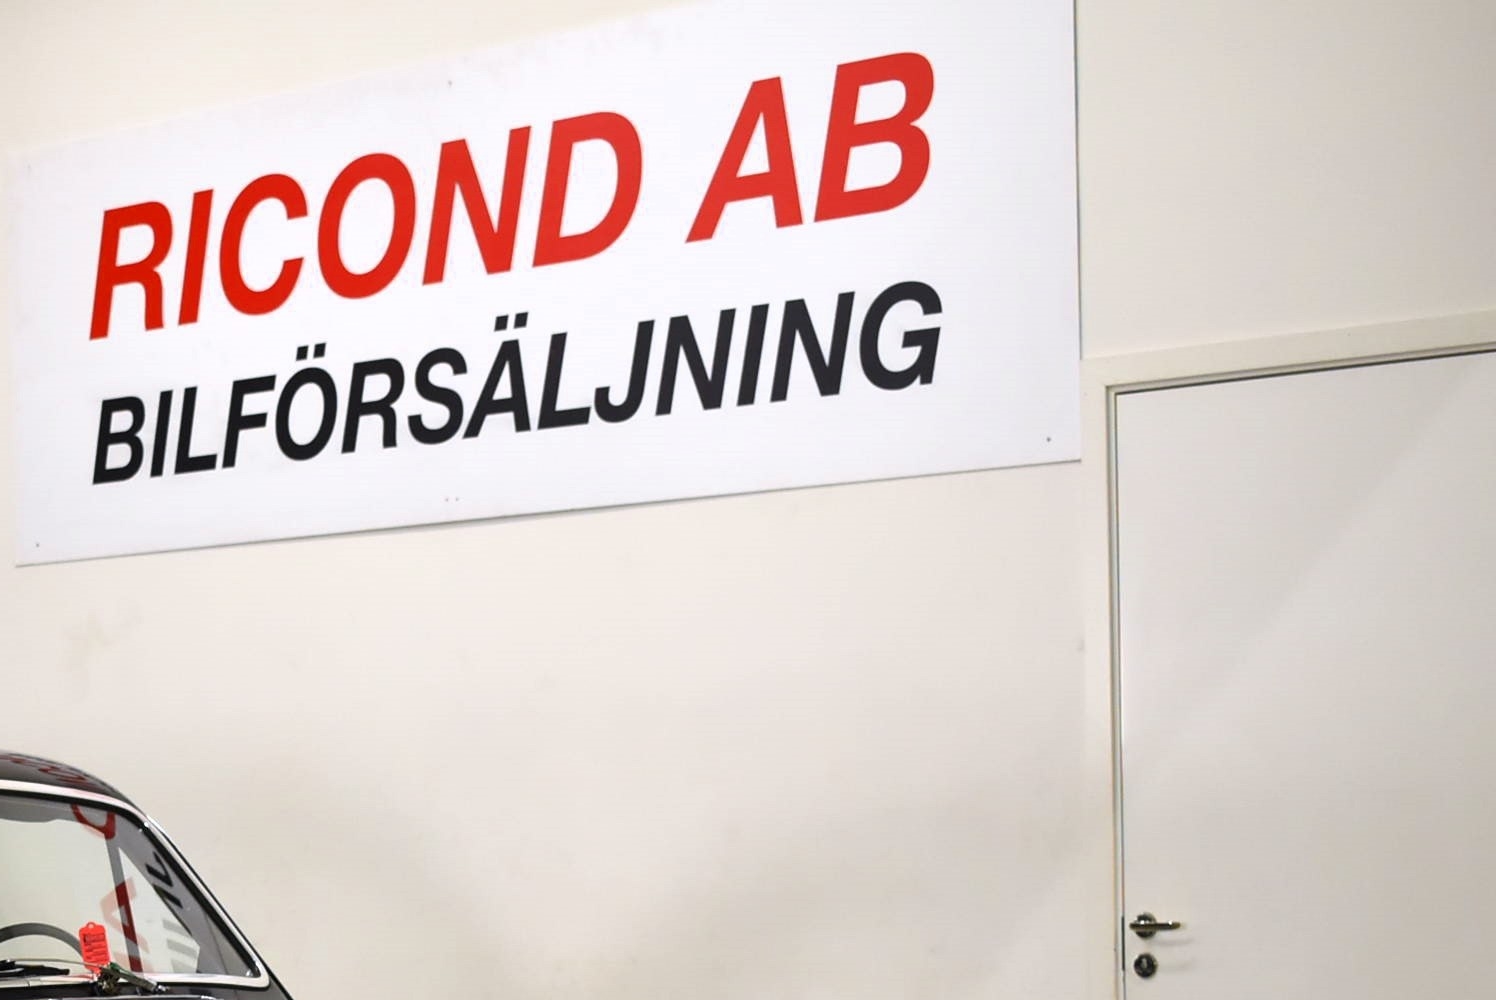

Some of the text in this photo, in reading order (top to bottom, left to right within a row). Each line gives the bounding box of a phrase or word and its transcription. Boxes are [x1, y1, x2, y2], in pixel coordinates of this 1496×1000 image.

[89, 51, 935, 340] RICOND AB
[92, 280, 943, 485] BILFÖRSÄLJNING
